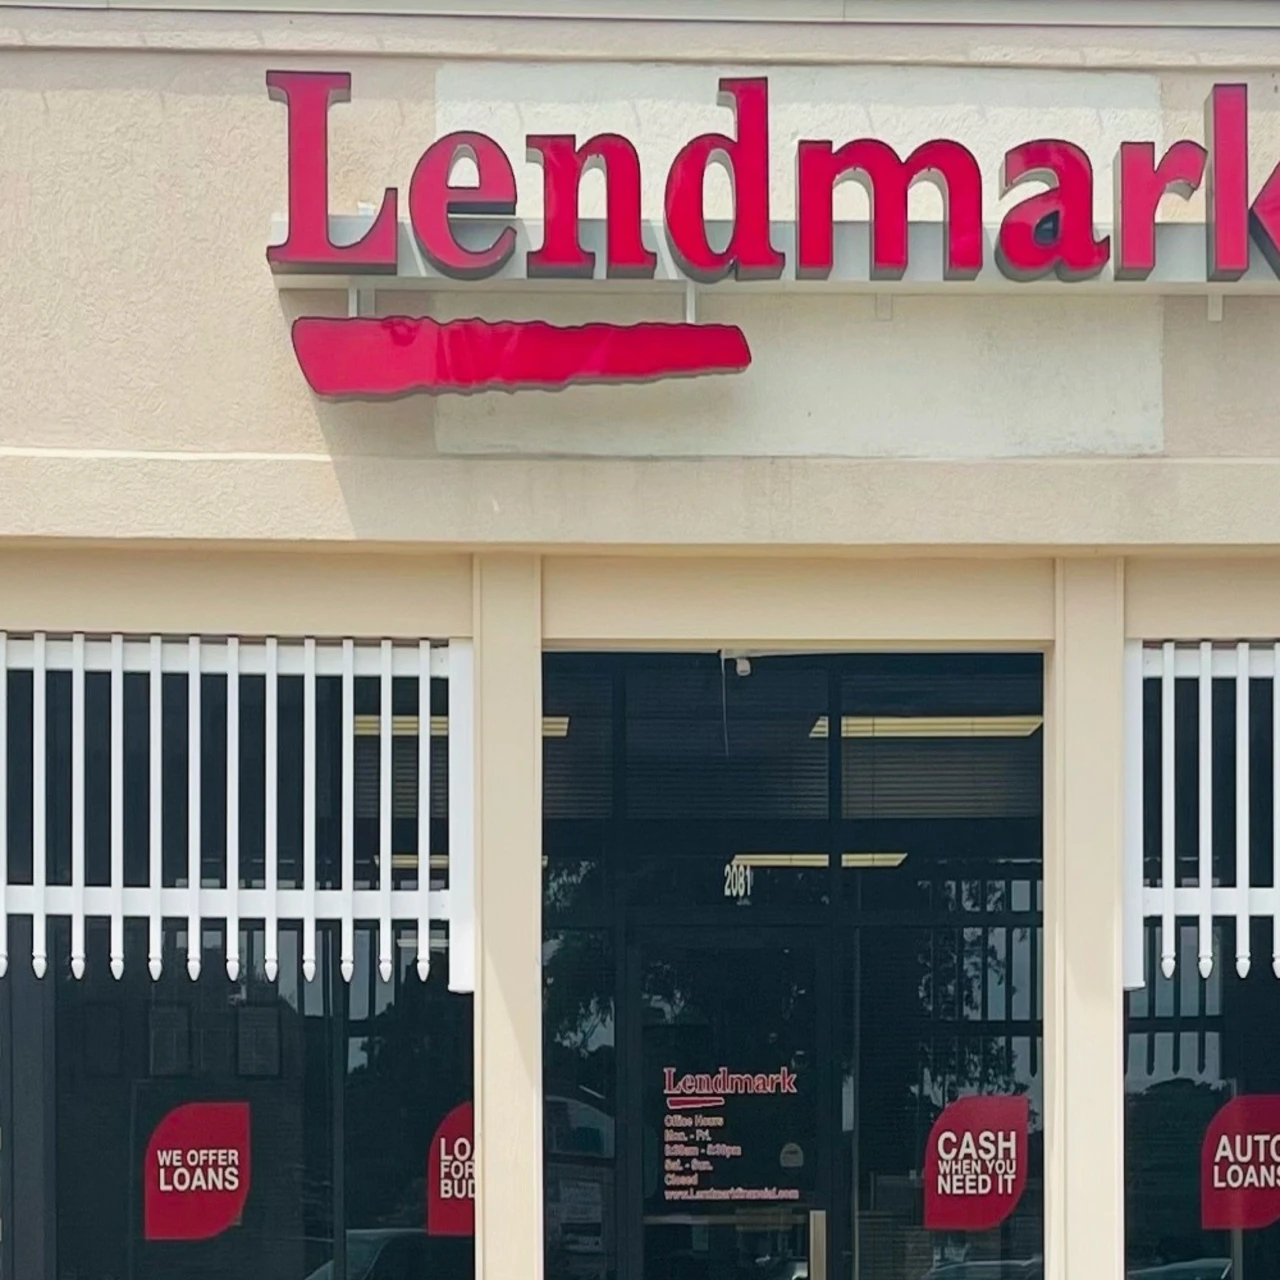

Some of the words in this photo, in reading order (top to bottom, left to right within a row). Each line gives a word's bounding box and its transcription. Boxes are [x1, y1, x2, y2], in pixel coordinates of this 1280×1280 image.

[723, 863, 751, 897] 2081
[663, 1066, 798, 1094] Lendmark
[440, 1137, 475, 1161] LO
[937, 1130, 1016, 1160] CASH
[157, 1149, 182, 1166] WE
[186, 1149, 239, 1167] OFFER
[938, 1159, 981, 1175] WHEN
[985, 1159, 1016, 1175] YOU
[160, 1167, 239, 1191] LOANS
[938, 1174, 992, 1195] NEED
[997, 1174, 1016, 1195] IT
